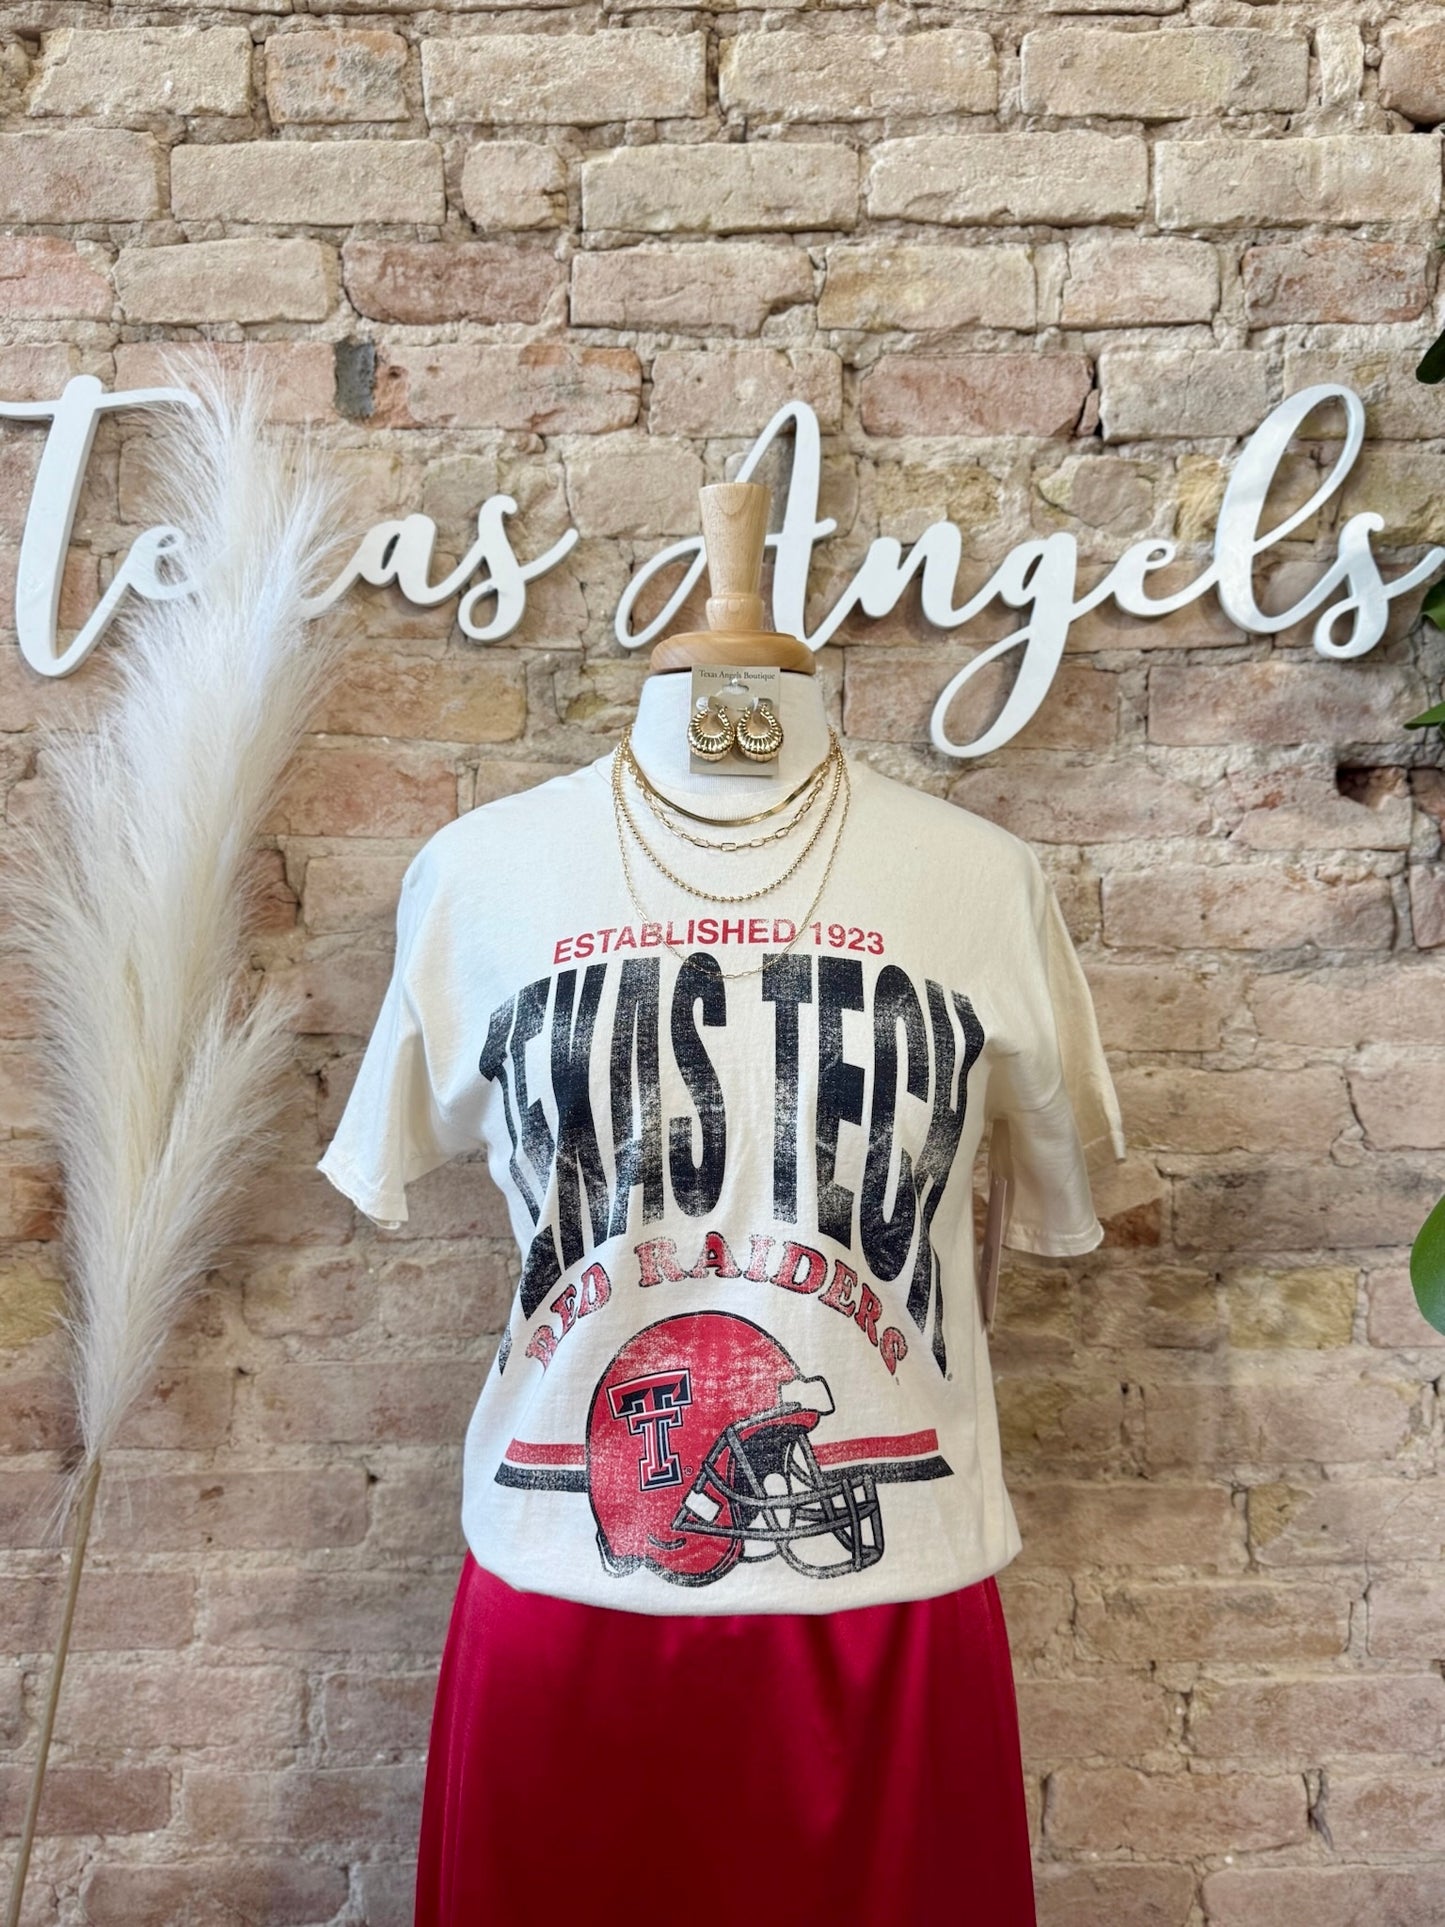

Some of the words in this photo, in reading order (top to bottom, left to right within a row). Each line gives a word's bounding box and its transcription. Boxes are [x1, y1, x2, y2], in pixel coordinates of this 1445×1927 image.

[0, 374, 579, 677] Teas
[614, 383, 1445, 758] Angels
[700, 669, 717, 678] Texas
[719, 671, 741, 681] Angels
[744, 671, 775, 682] Boutique
[553, 918, 797, 964] ESTABLISHED
[809, 921, 884, 955] 1923
[762, 953, 986, 1379] TECH
[526, 1262, 612, 1372] RED
[634, 1231, 908, 1376] RAIDERS
